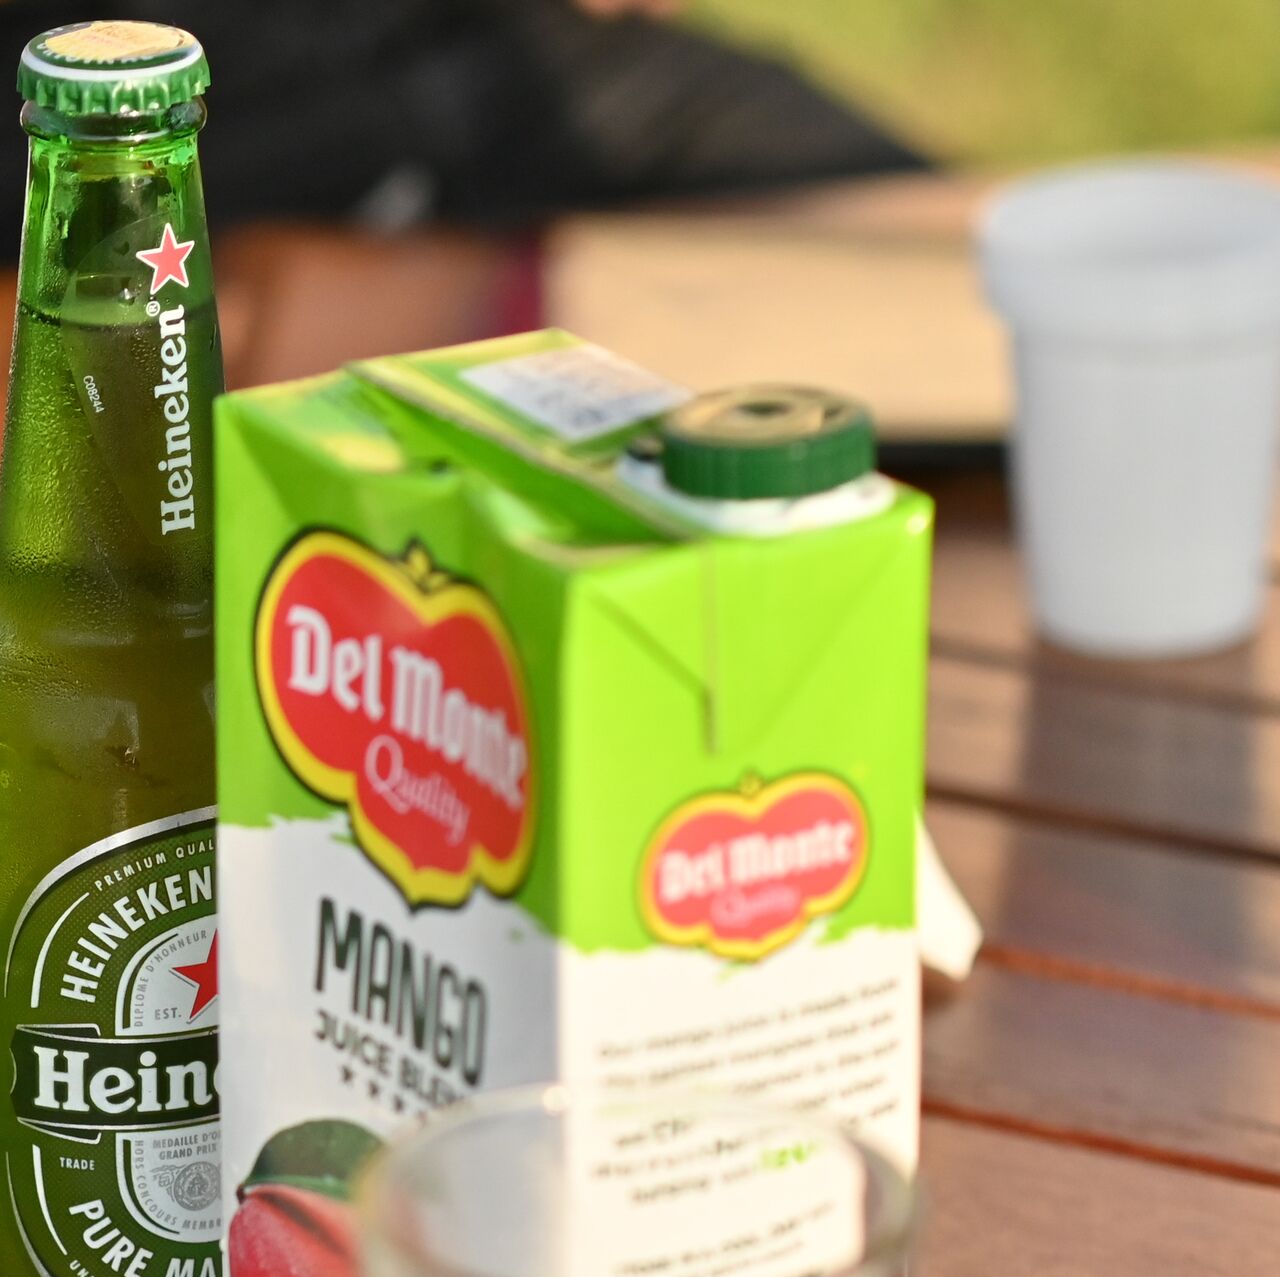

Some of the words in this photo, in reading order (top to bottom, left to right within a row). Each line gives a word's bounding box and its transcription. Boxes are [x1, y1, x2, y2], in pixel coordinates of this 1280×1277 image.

[83, 375, 105, 413] C08244
[286, 603, 384, 722] Del
[390, 645, 527, 812] Monte
[364, 734, 471, 844] Quality
[94, 852, 167, 892] PREMIUM
[660, 842, 725, 905] Del
[729, 818, 853, 884] Monte
[60, 866, 212, 1003] HEINEKEN
[134, 976, 149, 1027] DIPLOME
[145, 930, 207, 973] D'HONNEUR
[315, 897, 487, 1087] MANGO
[154, 1008, 182, 1021] EST.
[315, 1007, 393, 1076] JUICE
[59, 1157, 95, 1171] TRADE
[134, 1140, 144, 1170] HORS
[153, 1134, 199, 1149] MEDAILLE
[159, 1146, 193, 1161] GRAND
[196, 1143, 217, 1156] PRIX
[136, 1175, 178, 1226] CONCOURS
